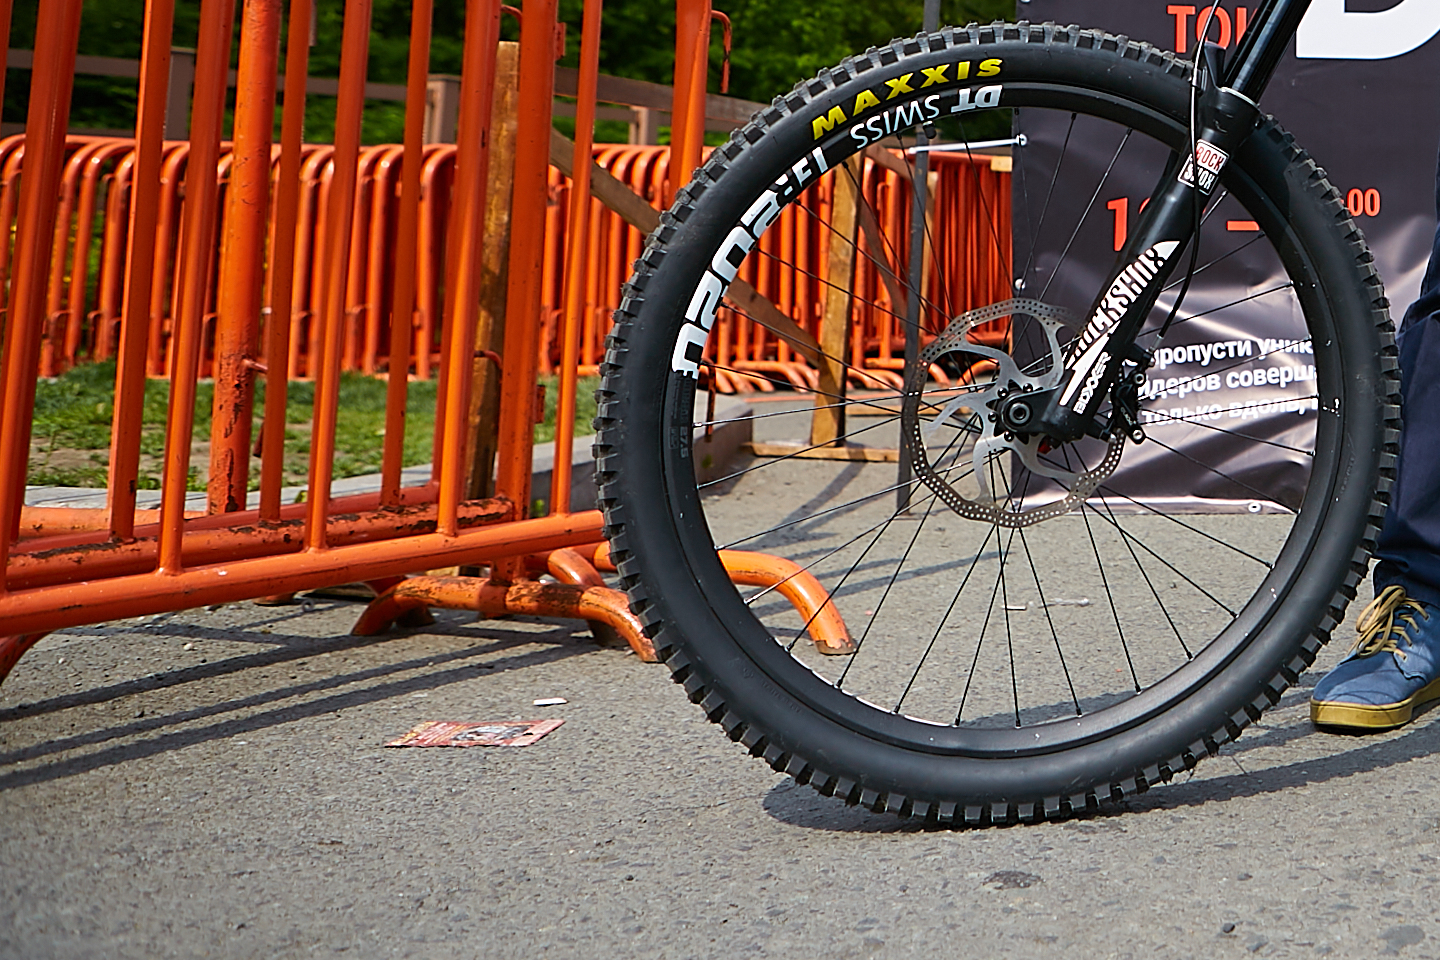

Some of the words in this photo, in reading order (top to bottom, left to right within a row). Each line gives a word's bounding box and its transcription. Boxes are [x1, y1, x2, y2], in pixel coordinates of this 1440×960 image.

[810, 58, 1004, 141] MAXXIS
[950, 84, 1003, 113] DT
[850, 94, 941, 149] SWISS
[1196, 146, 1224, 172] ROCK
[1072, 350, 1112, 415] BOXXER
[1141, 402, 1223, 427] только
